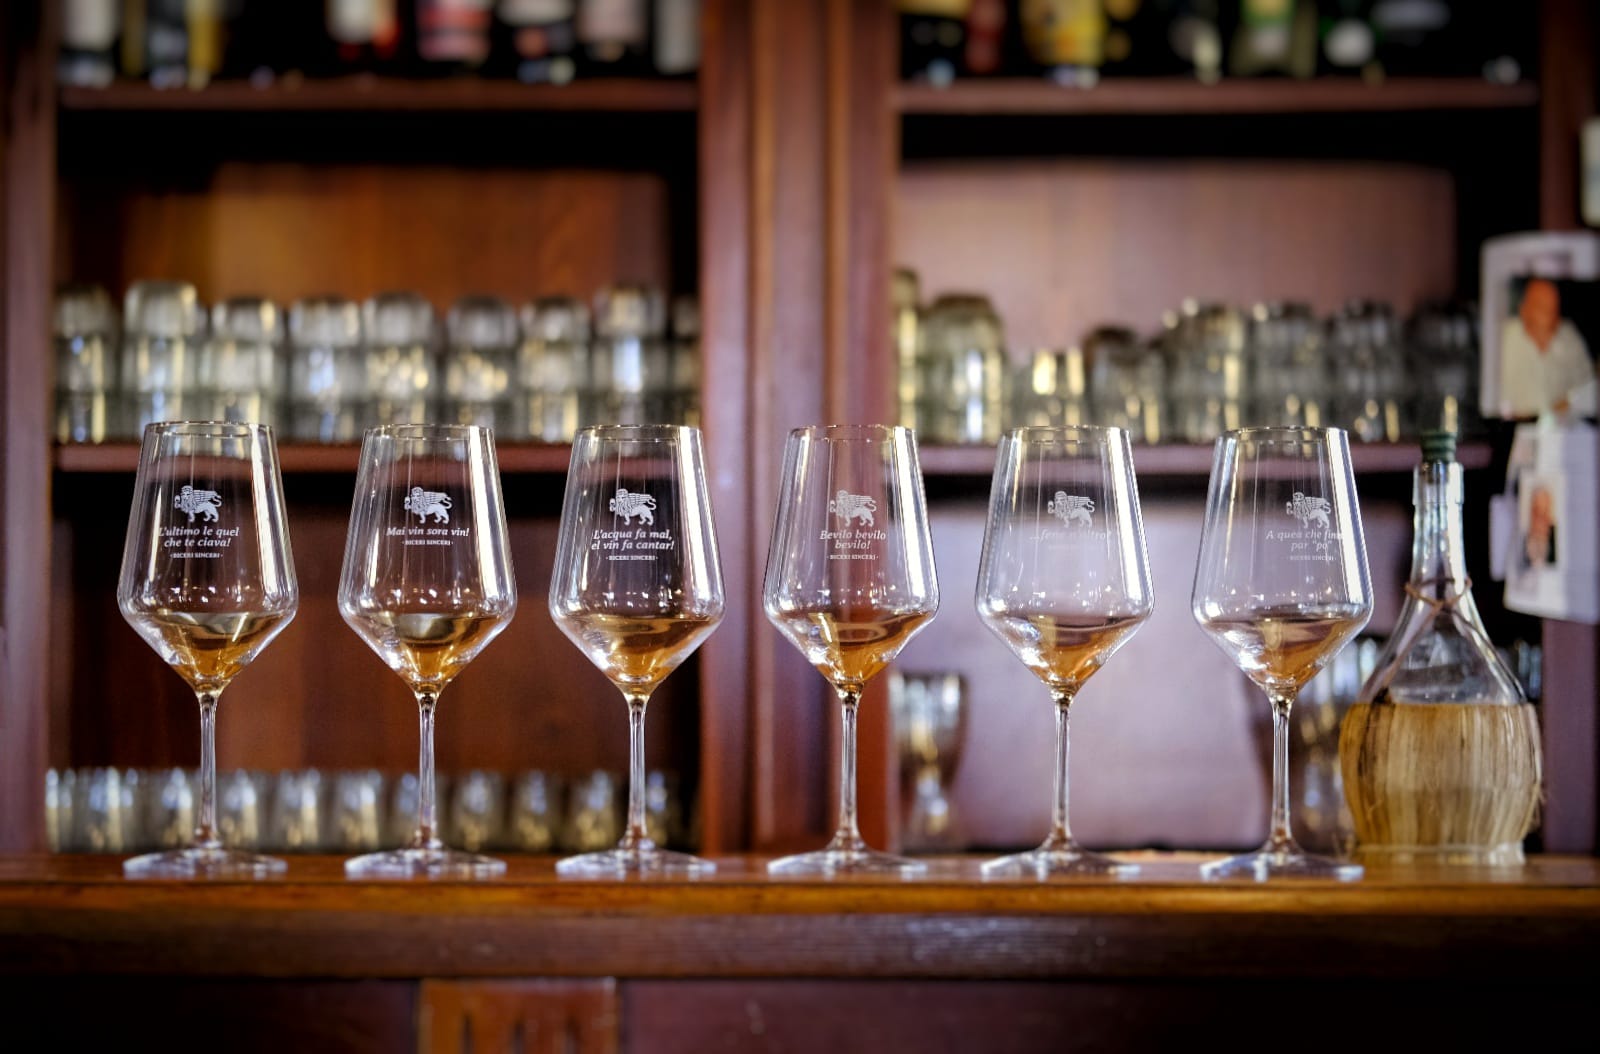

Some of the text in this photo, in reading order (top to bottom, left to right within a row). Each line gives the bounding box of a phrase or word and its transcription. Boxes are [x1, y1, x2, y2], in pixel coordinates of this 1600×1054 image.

[203, 525, 213, 537] le
[216, 527, 239, 538] quel
[386, 526, 470, 537] Mai vin sora vin!
[593, 528, 673, 541] L'acqua fa mal,
[820, 529, 886, 540] Bevilo bevilo
[1266, 530, 1274, 540] A
[164, 537, 181, 547] che
[184, 538, 196, 547] te
[591, 540, 675, 551] el vin fa cantar!
[835, 540, 871, 550] bevilo!
[1291, 542, 1308, 552] par
